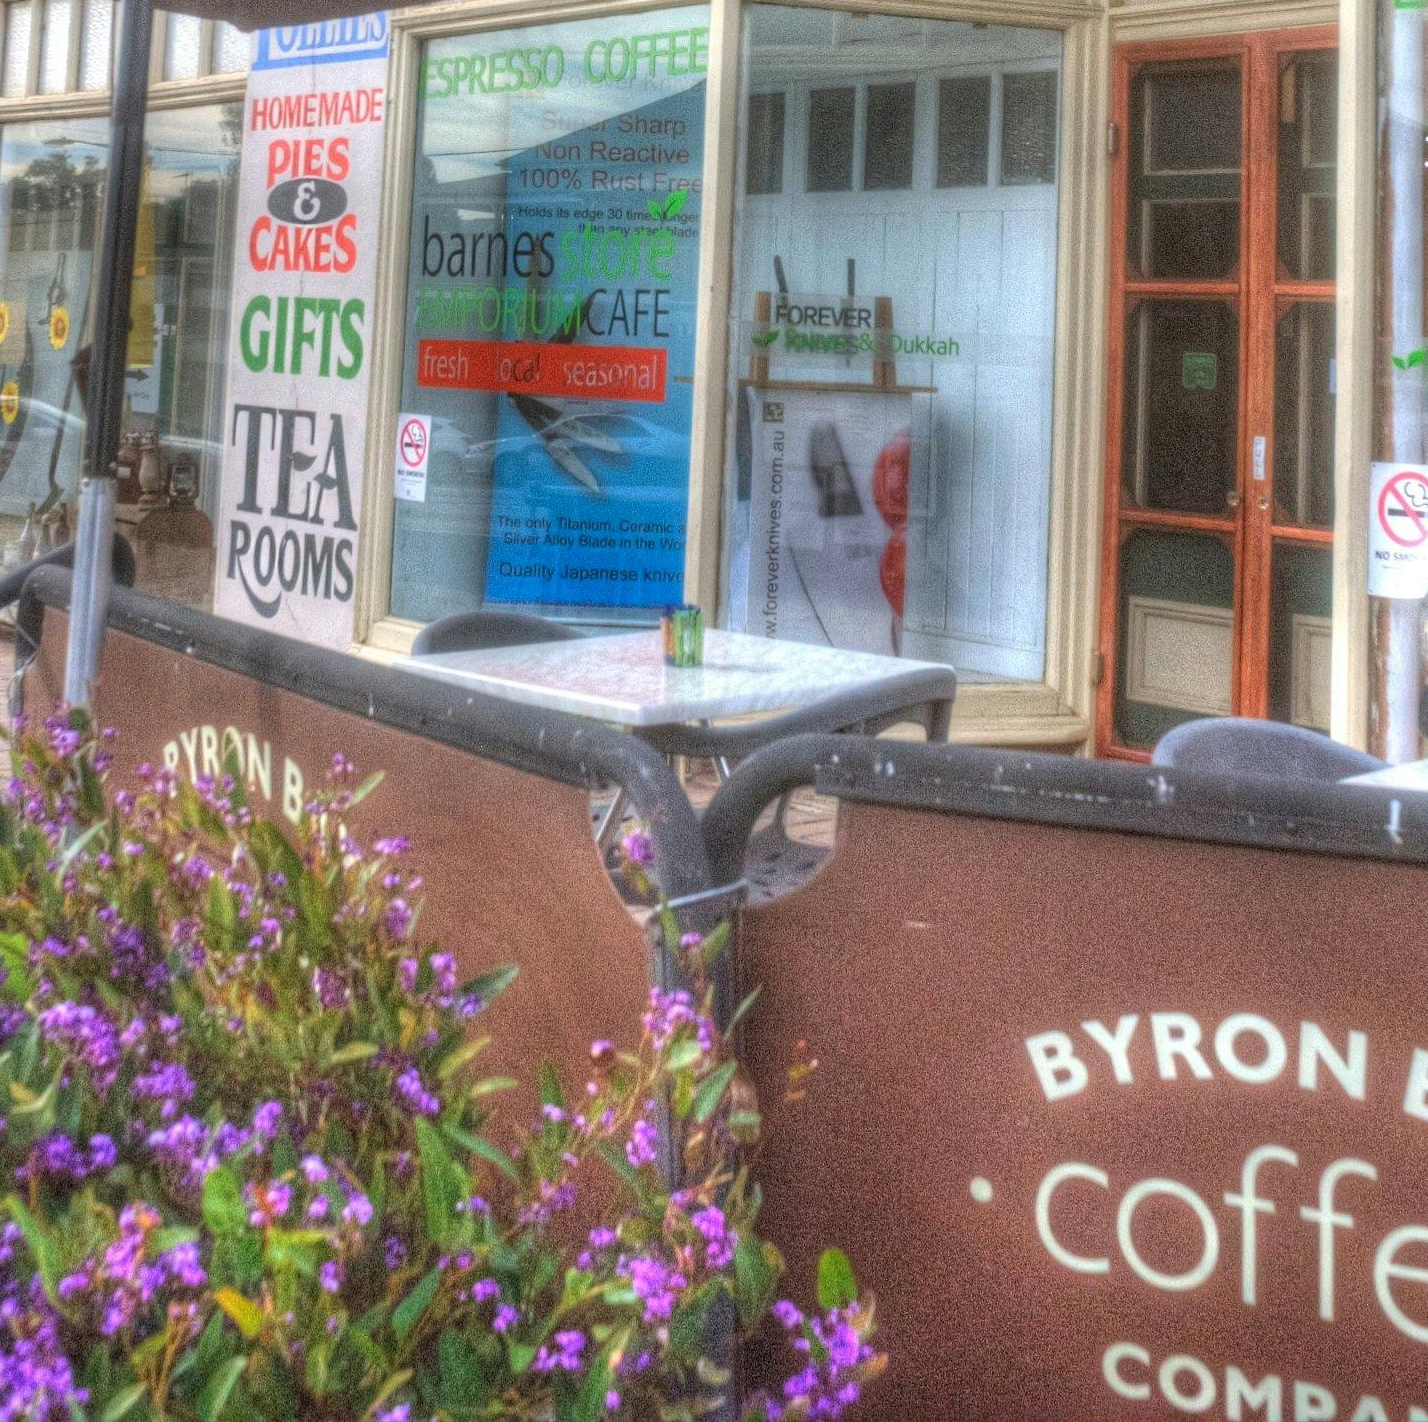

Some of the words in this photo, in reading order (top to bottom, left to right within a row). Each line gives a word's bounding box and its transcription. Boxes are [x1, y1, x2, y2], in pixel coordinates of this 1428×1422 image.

[423, 44, 564, 100] ESPRESSO
[584, 27, 708, 84] COFFEE
[251, 88, 383, 131] HOMEMADE
[618, 114, 687, 138] Sharp
[266, 137, 349, 190] PIES
[535, 143, 581, 160] Non
[590, 141, 689, 163] Reactive
[293, 180, 320, 221] &
[521, 168, 582, 189] 100%
[592, 169, 644, 191] Rust
[654, 171, 703, 193] Free
[574, 209, 604, 221] edge
[626, 210, 655, 220] time
[249, 213, 357, 273] CAKES
[240, 294, 365, 380] GIFTS
[775, 306, 872, 328] FOREVER
[889, 333, 960, 355] Dukkah
[423, 346, 469, 379] fresh
[563, 354, 658, 390] seasonal
[231, 404, 358, 531] TEA
[504, 532, 539, 545] Silver
[579, 535, 617, 548] Blade
[635, 537, 655, 549] the
[525, 518, 552, 531] only
[227, 520, 354, 619] ROOMS
[500, 562, 555, 582] Quality
[563, 565, 637, 582] Japanese
[1024, 1011, 1369, 1103] BYRON
